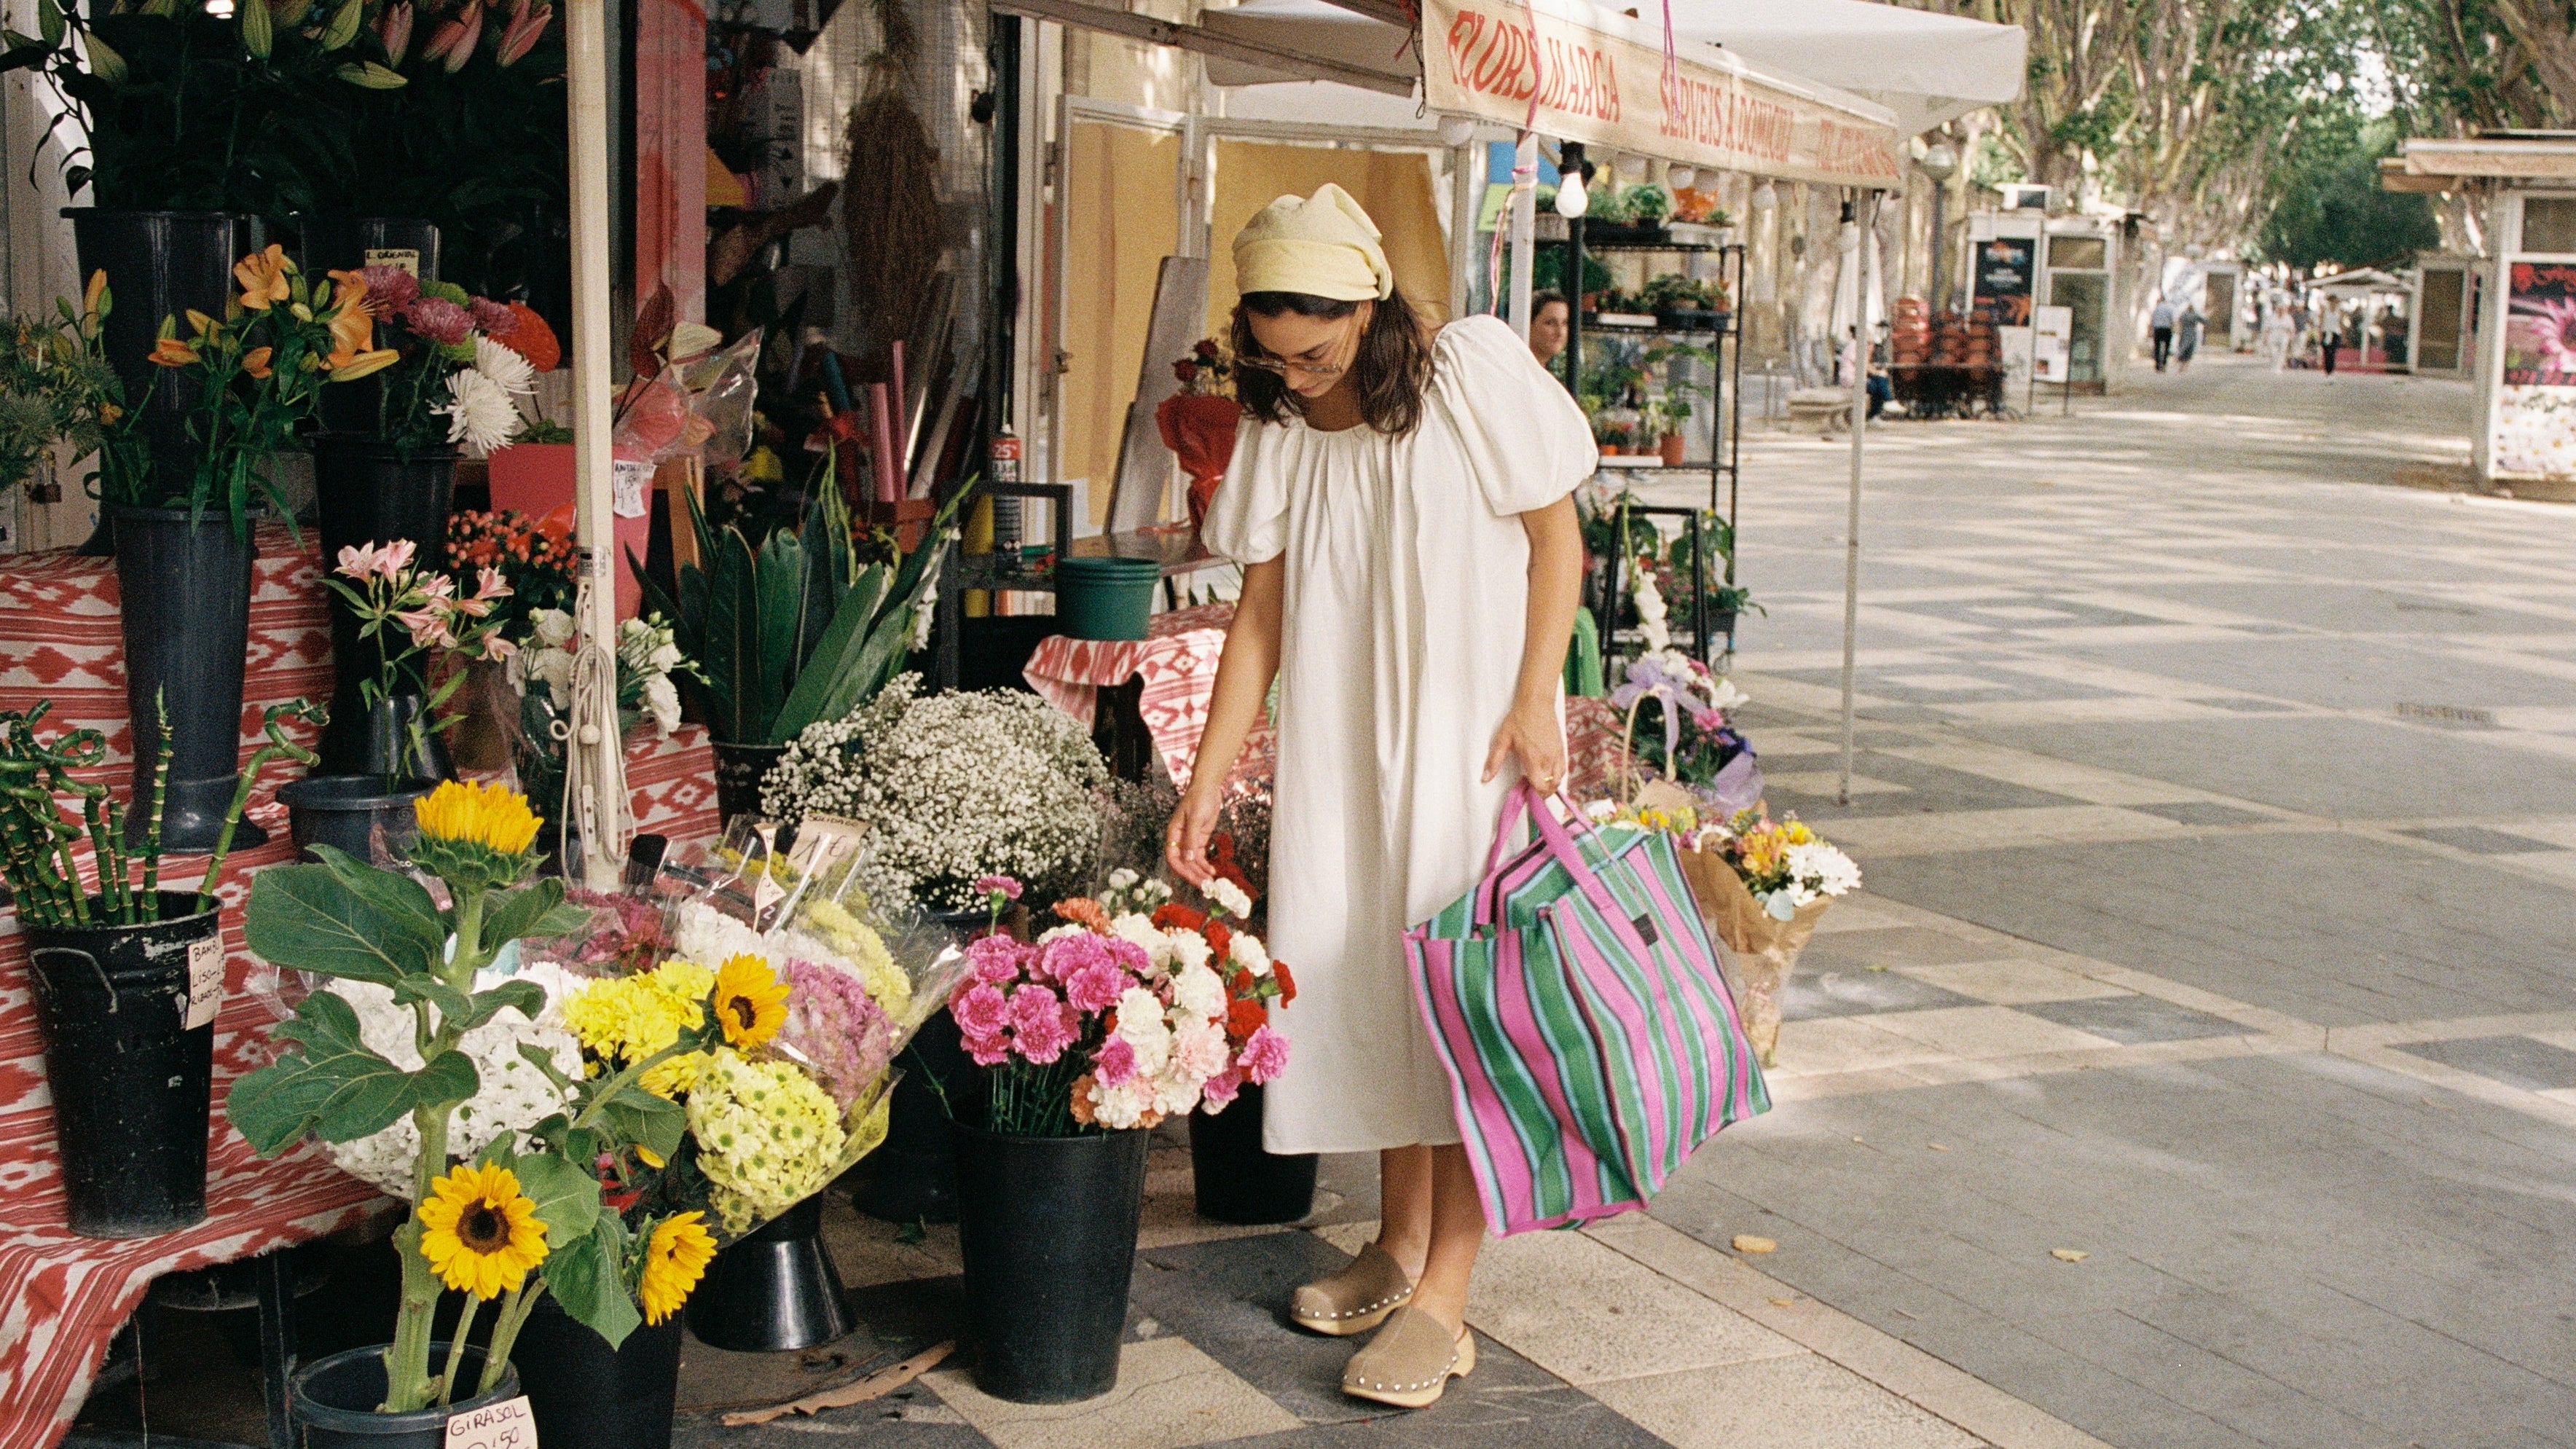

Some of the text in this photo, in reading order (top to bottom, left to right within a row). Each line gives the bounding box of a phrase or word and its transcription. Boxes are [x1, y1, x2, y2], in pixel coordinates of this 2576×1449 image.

[1447, 9, 1620, 122] FLORS MARGA
[1660, 71, 1722, 148] SERVEIS
